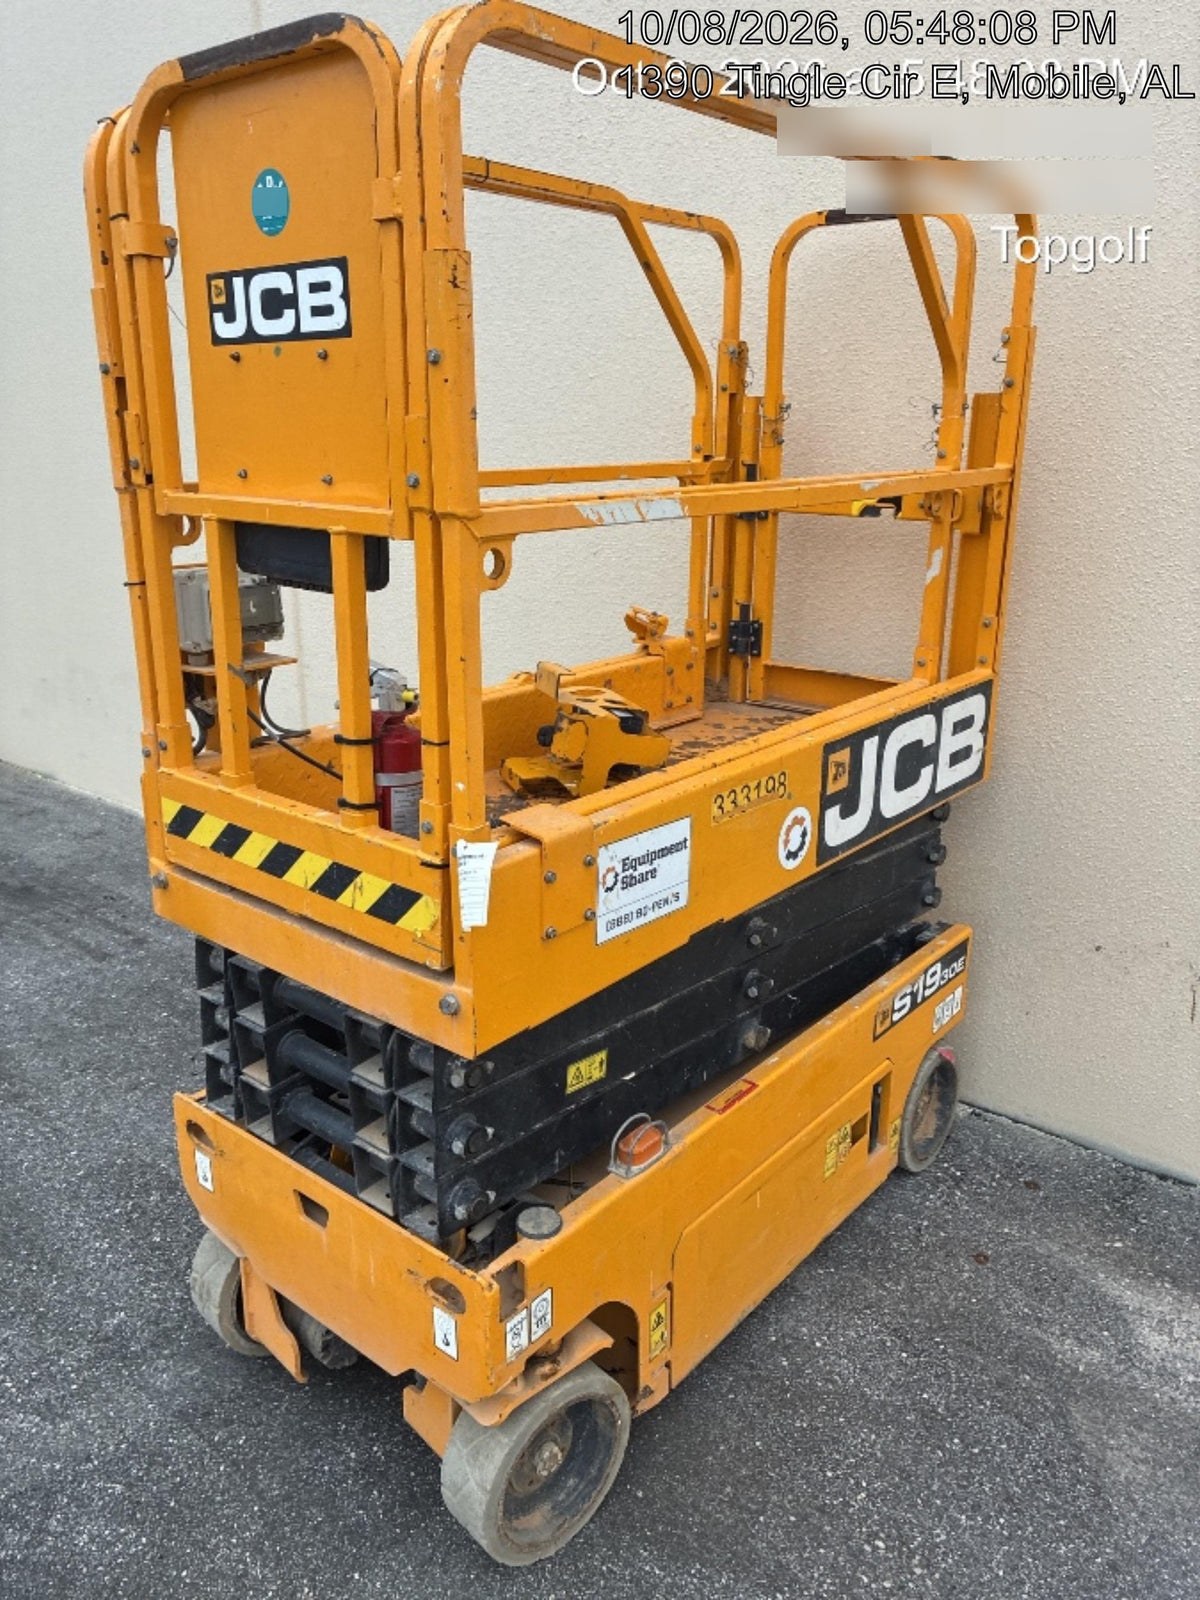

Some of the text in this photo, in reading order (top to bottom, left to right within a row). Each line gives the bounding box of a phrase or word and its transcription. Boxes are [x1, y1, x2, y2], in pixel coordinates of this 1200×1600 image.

[212, 265, 348, 339] JCB
[713, 770, 788, 816] 333198
[824, 693, 987, 848] JCB
[620, 866, 658, 891] Share
[621, 837, 688, 874] Equipment
